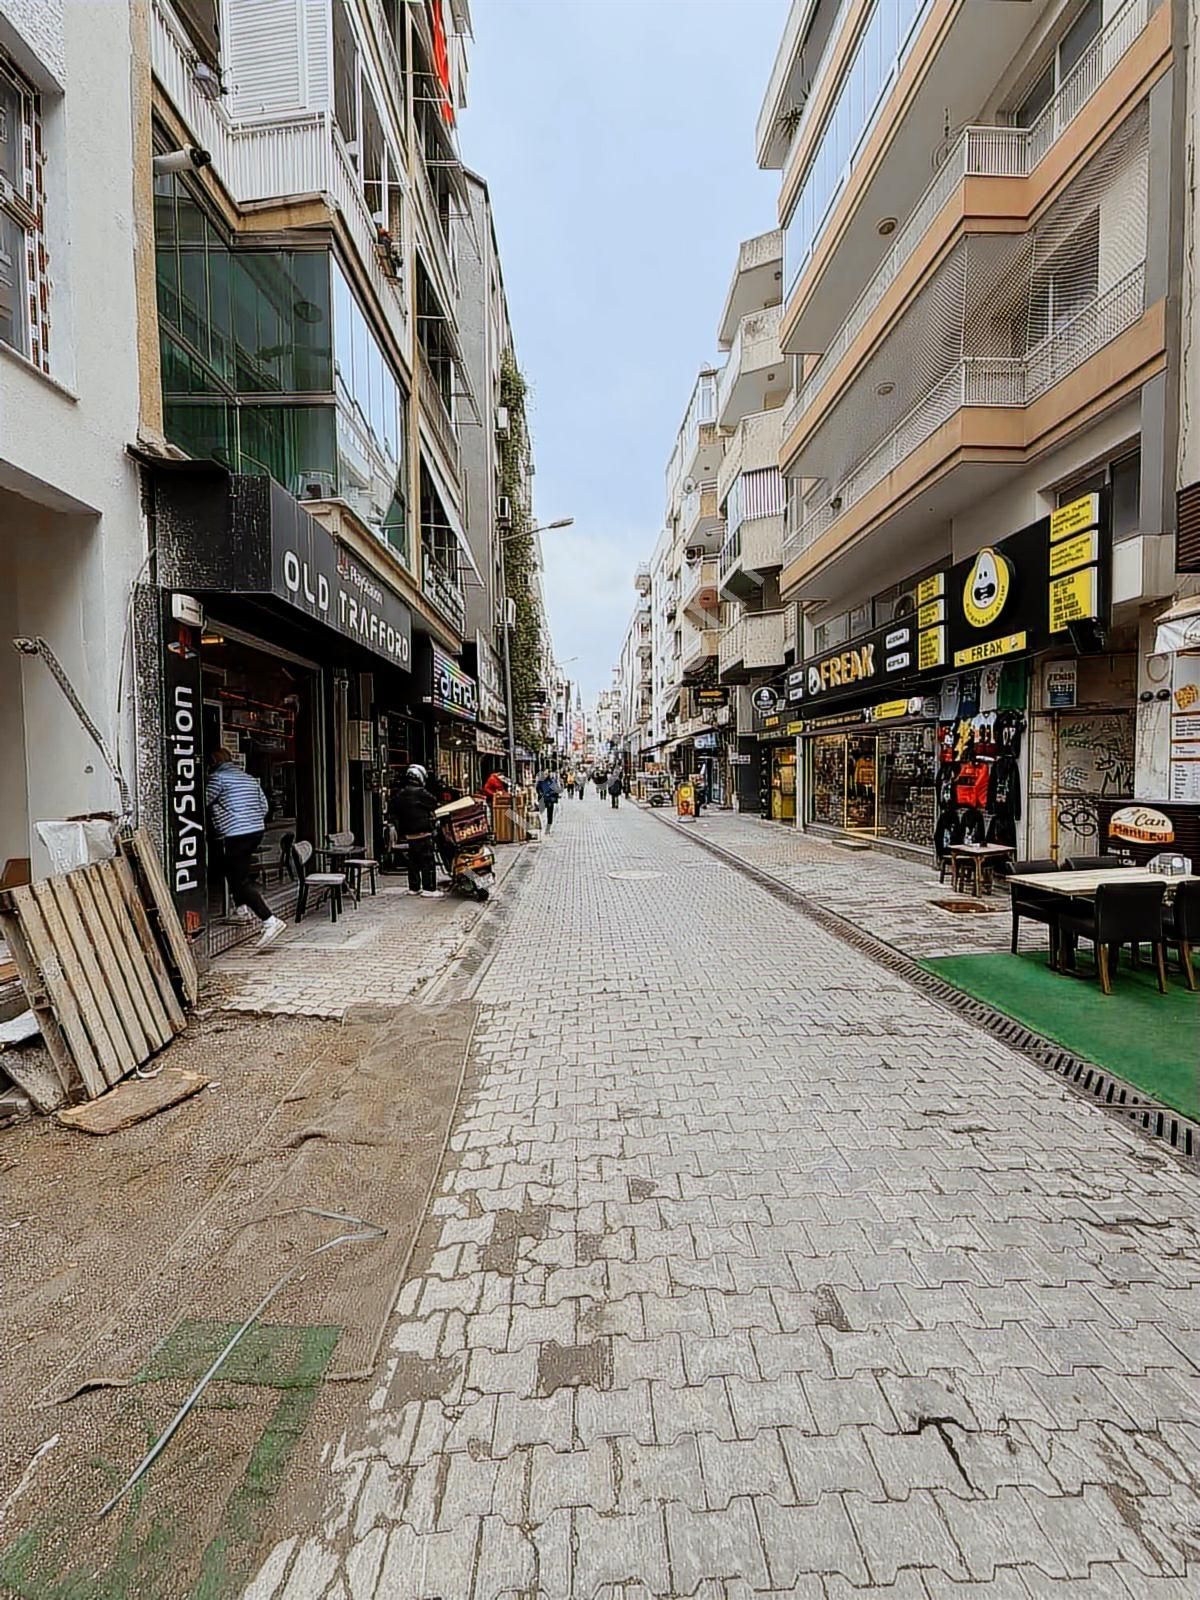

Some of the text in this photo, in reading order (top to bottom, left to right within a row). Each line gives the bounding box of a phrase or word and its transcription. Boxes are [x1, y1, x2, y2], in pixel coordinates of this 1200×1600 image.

[284, 551, 329, 612] OLD
[339, 590, 409, 662] TRAFFORD
[820, 643, 875, 692] FREAK
[970, 639, 1003, 661] FREAK
[173, 686, 203, 892] PlayStation
[1134, 812, 1166, 828] Can
